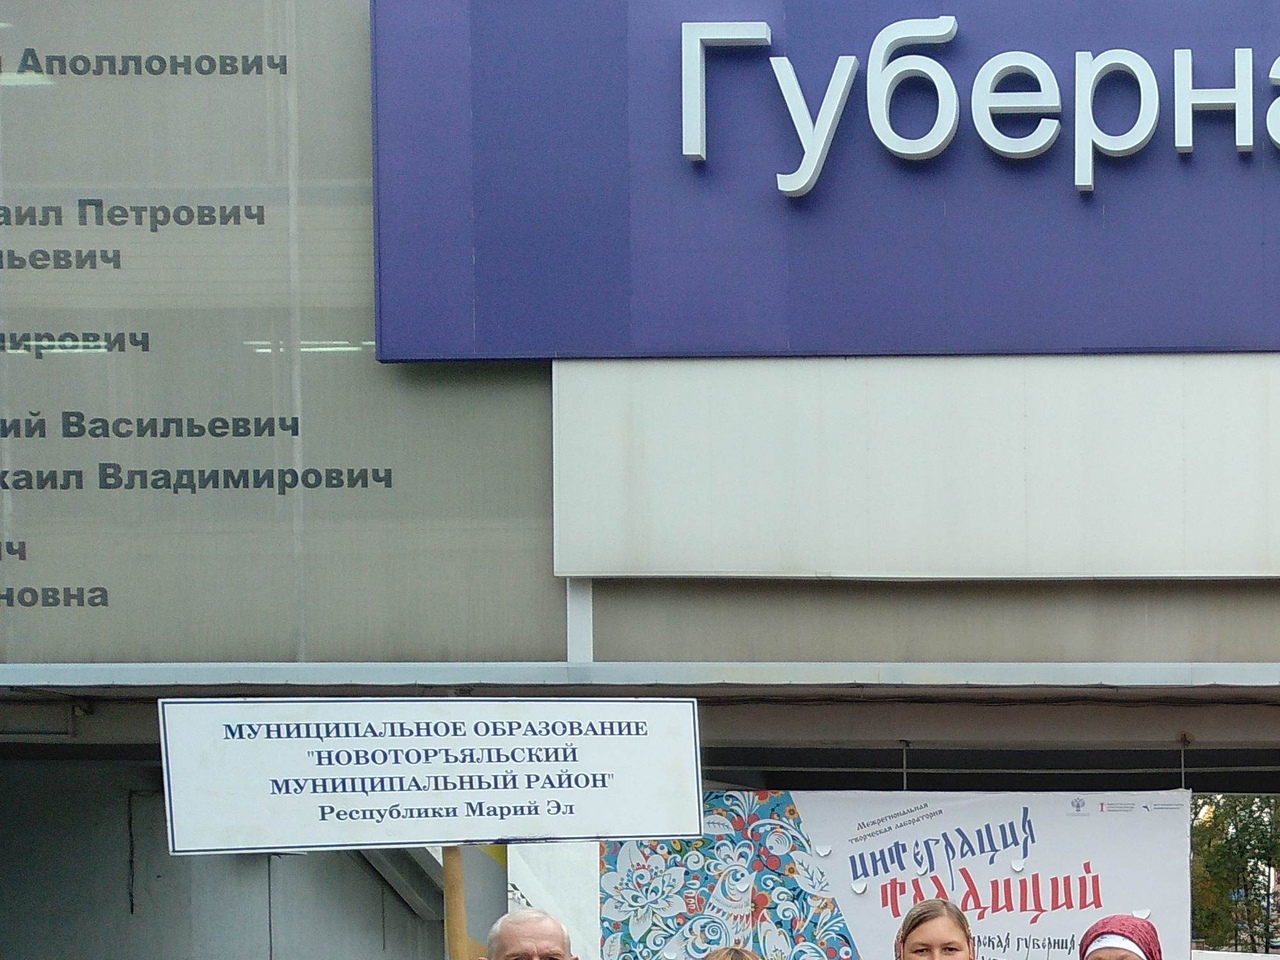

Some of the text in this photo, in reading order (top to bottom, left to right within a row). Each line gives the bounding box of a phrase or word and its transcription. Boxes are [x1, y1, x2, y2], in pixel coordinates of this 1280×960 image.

[17, 48, 289, 76] Аполлонович
[77, 199, 265, 232] Петрович
[0, 250, 121, 269] ьевич
[0, 332, 149, 359] ирович
[61, 411, 299, 438] Васильевич
[98, 463, 393, 495] Владимирович
[222, 719, 649, 742] МУНИЦИПАЛЬНОЕ ОБРАЗОВАНИЕ
[306, 745, 579, 767] "НОВОТОРЪЯЛЬСКИЙ
[268, 770, 615, 796] МУНИЦИПАЛЬНЫЙ РАЙОН"
[318, 799, 576, 822] Республики Марий Эл
